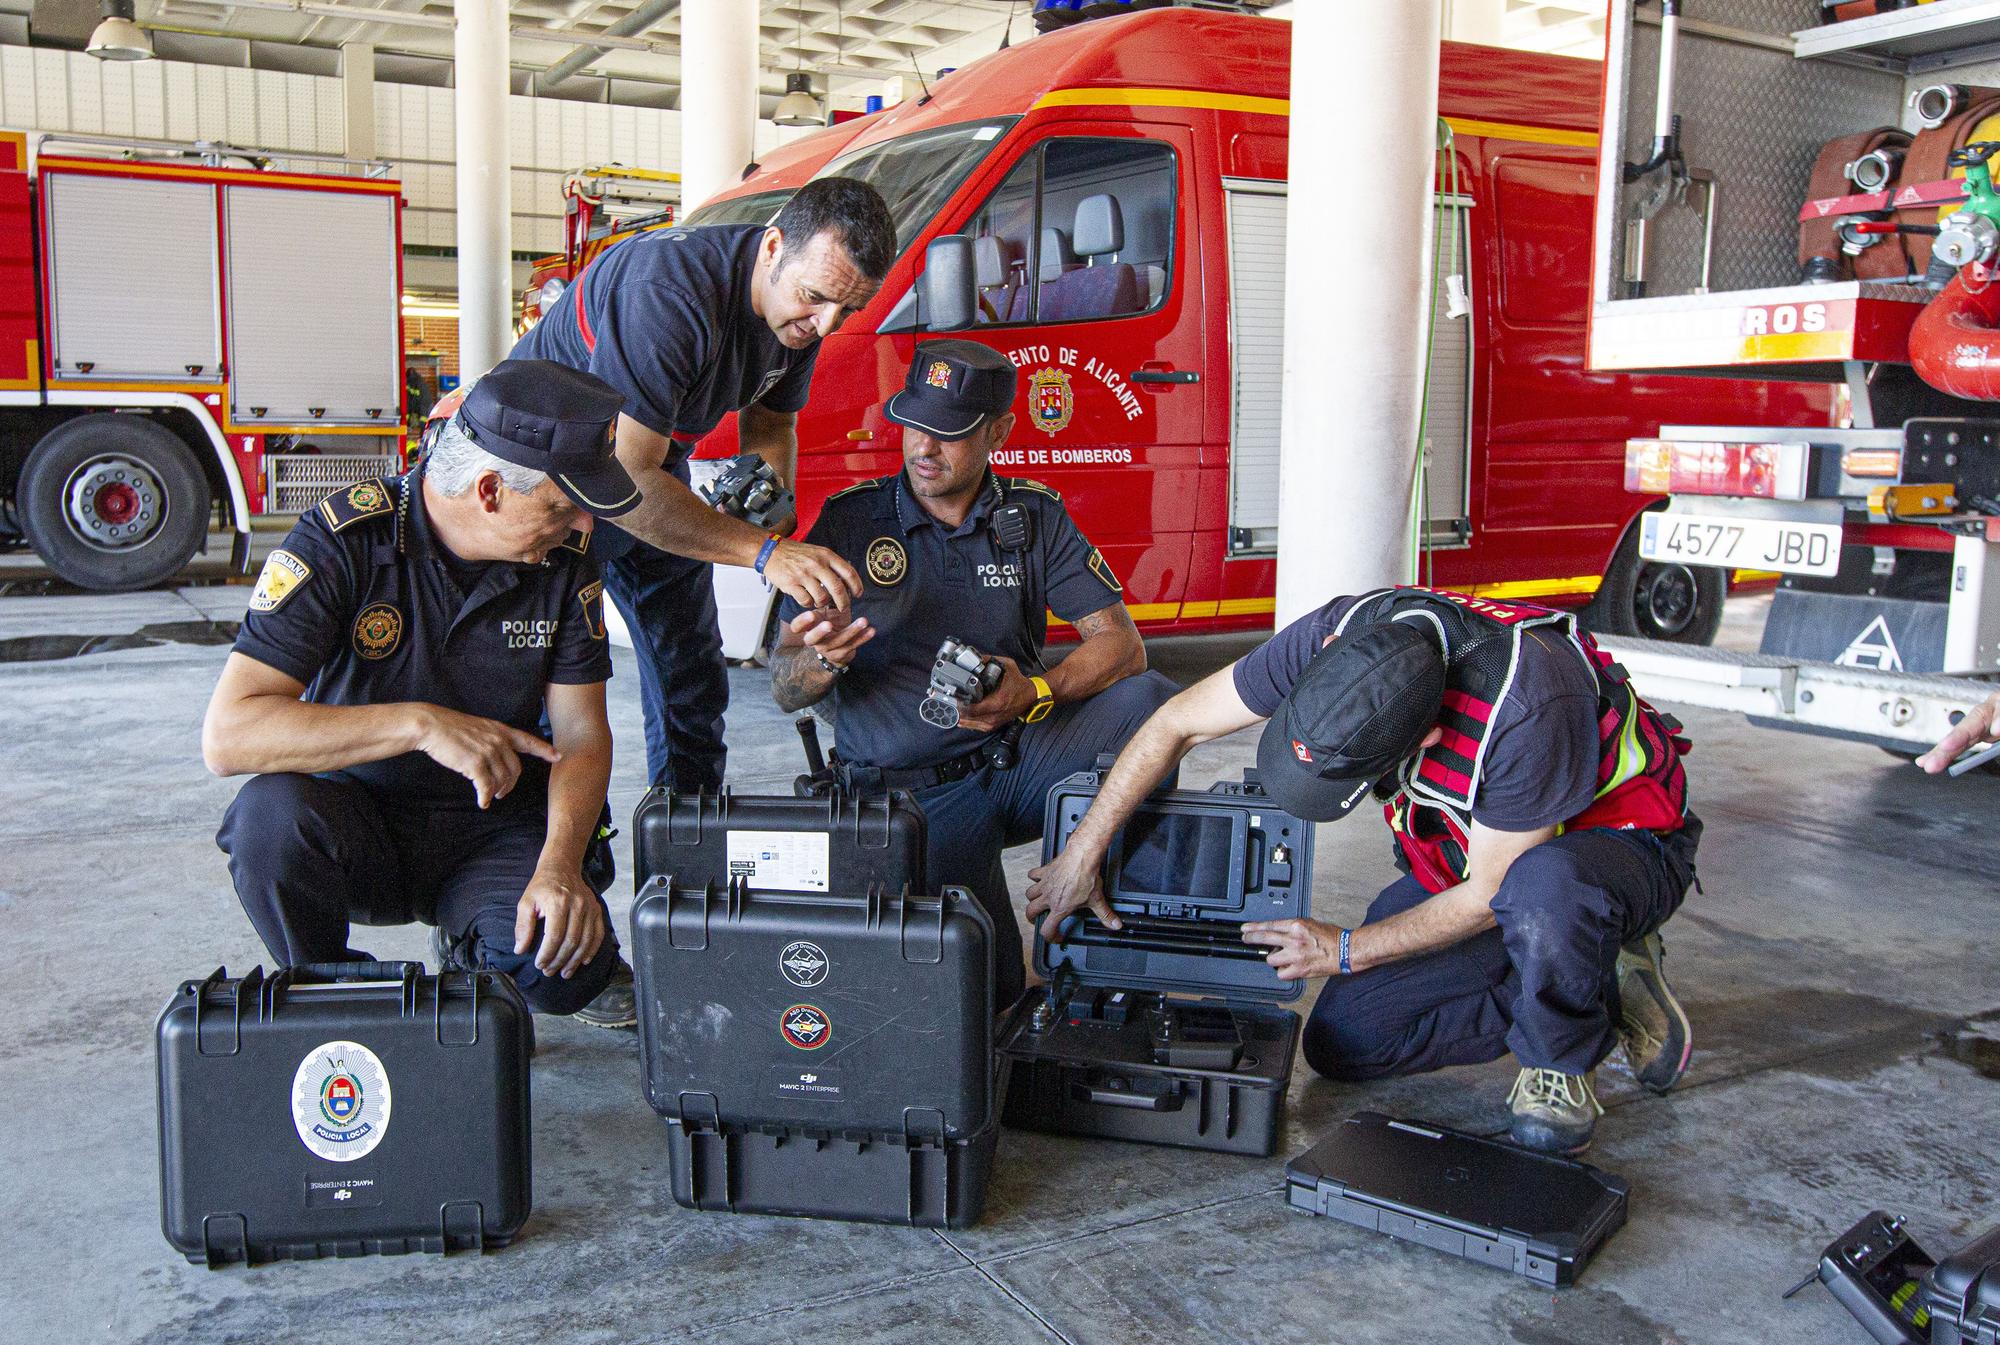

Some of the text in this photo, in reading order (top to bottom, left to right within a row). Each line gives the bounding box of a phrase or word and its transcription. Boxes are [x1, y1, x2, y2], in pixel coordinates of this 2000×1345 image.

[1007, 345, 1144, 421] ENTO DE ALICANTE
[1028, 450, 1049, 464] DE
[1051, 449, 1132, 465] BOMBEROS
[1667, 522, 1829, 567] 4577 JBD
[977, 563, 1022, 576] POLCI
[983, 575, 1021, 588] LOCAL
[501, 620, 559, 634] POLICIA
[508, 634, 553, 648] LOCAL
[779, 1083, 800, 1091] MAVIC
[805, 1085, 840, 1093] ENTERPRISE
[316, 1126, 370, 1141] POLICIA LOCAL
[310, 1181, 346, 1189] ENTERPRISE
[352, 1179, 374, 1187] MAVIC
